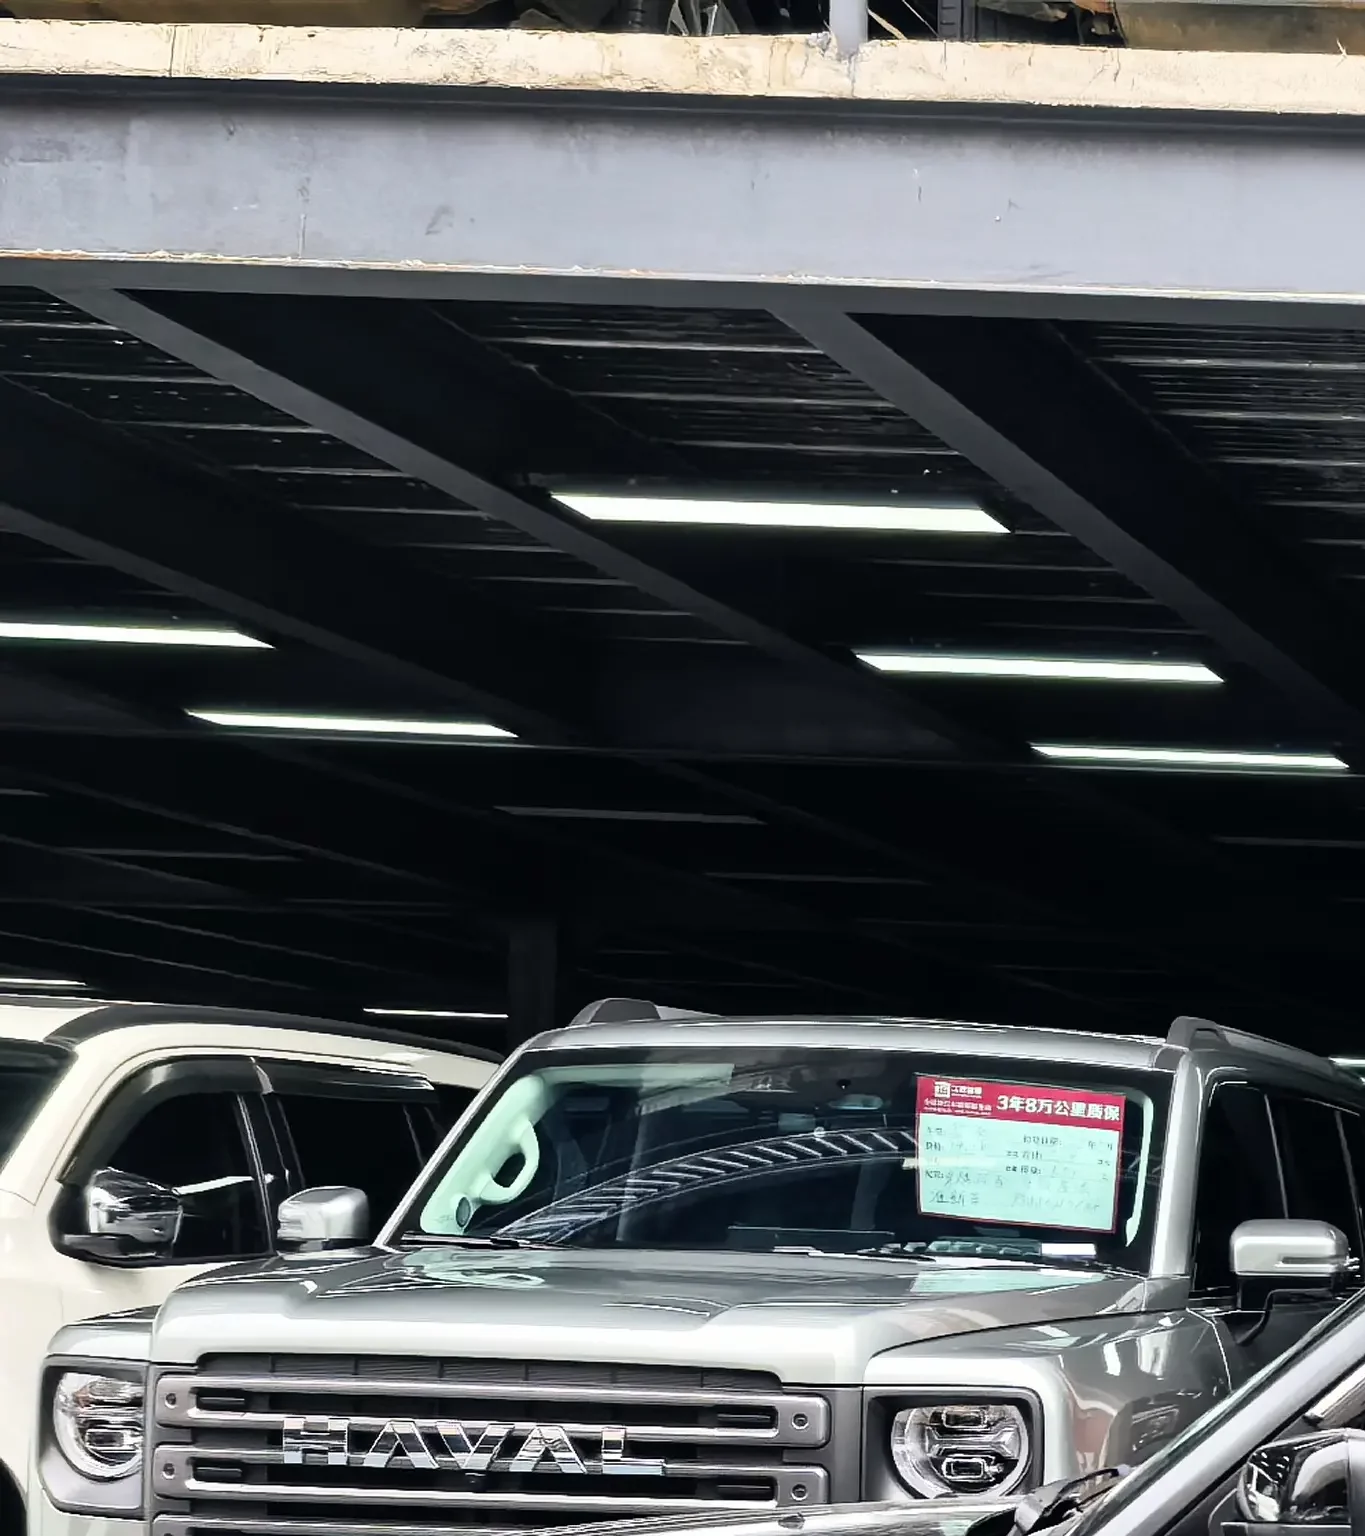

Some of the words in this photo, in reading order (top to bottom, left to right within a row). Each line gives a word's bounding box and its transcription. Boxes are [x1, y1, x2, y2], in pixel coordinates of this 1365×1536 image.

[996, 1094, 1121, 1122] 3年8万公里质保
[283, 1416, 665, 1475] HAVAL
